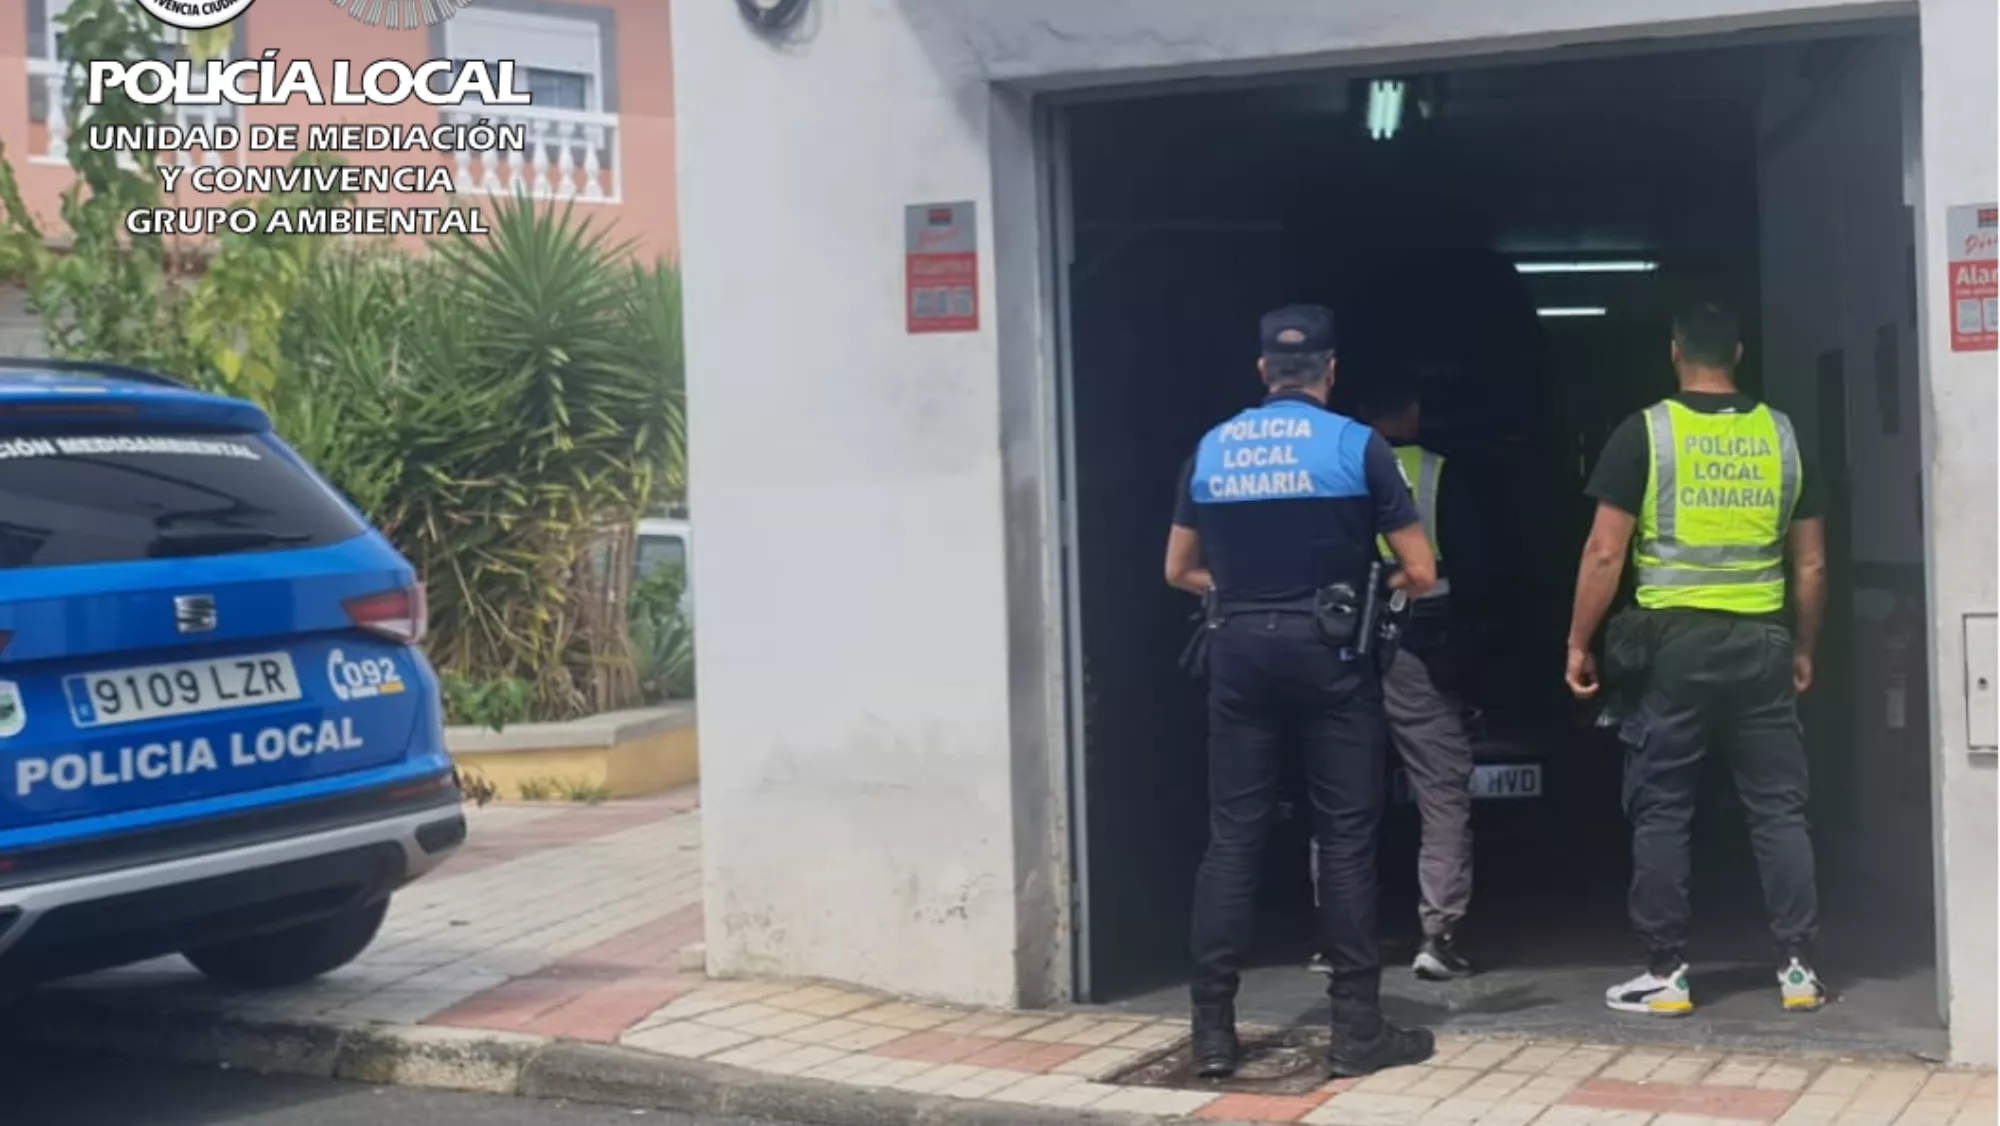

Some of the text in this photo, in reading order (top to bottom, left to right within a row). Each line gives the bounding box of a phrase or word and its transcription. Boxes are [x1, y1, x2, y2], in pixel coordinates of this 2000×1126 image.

[1220, 418, 1312, 443] POLICIA
[1223, 446, 1298, 468] LOCAL
[1685, 435, 1772, 457] POLICIA
[1208, 470, 1314, 497] CANARIA
[1694, 461, 1764, 481] LOCAL
[1680, 486, 1776, 508] CANARIA
[343, 657, 401, 687] 092
[95, 660, 286, 715] 9109 LZR
[16, 717, 363, 795] POLICIA LOCAL
